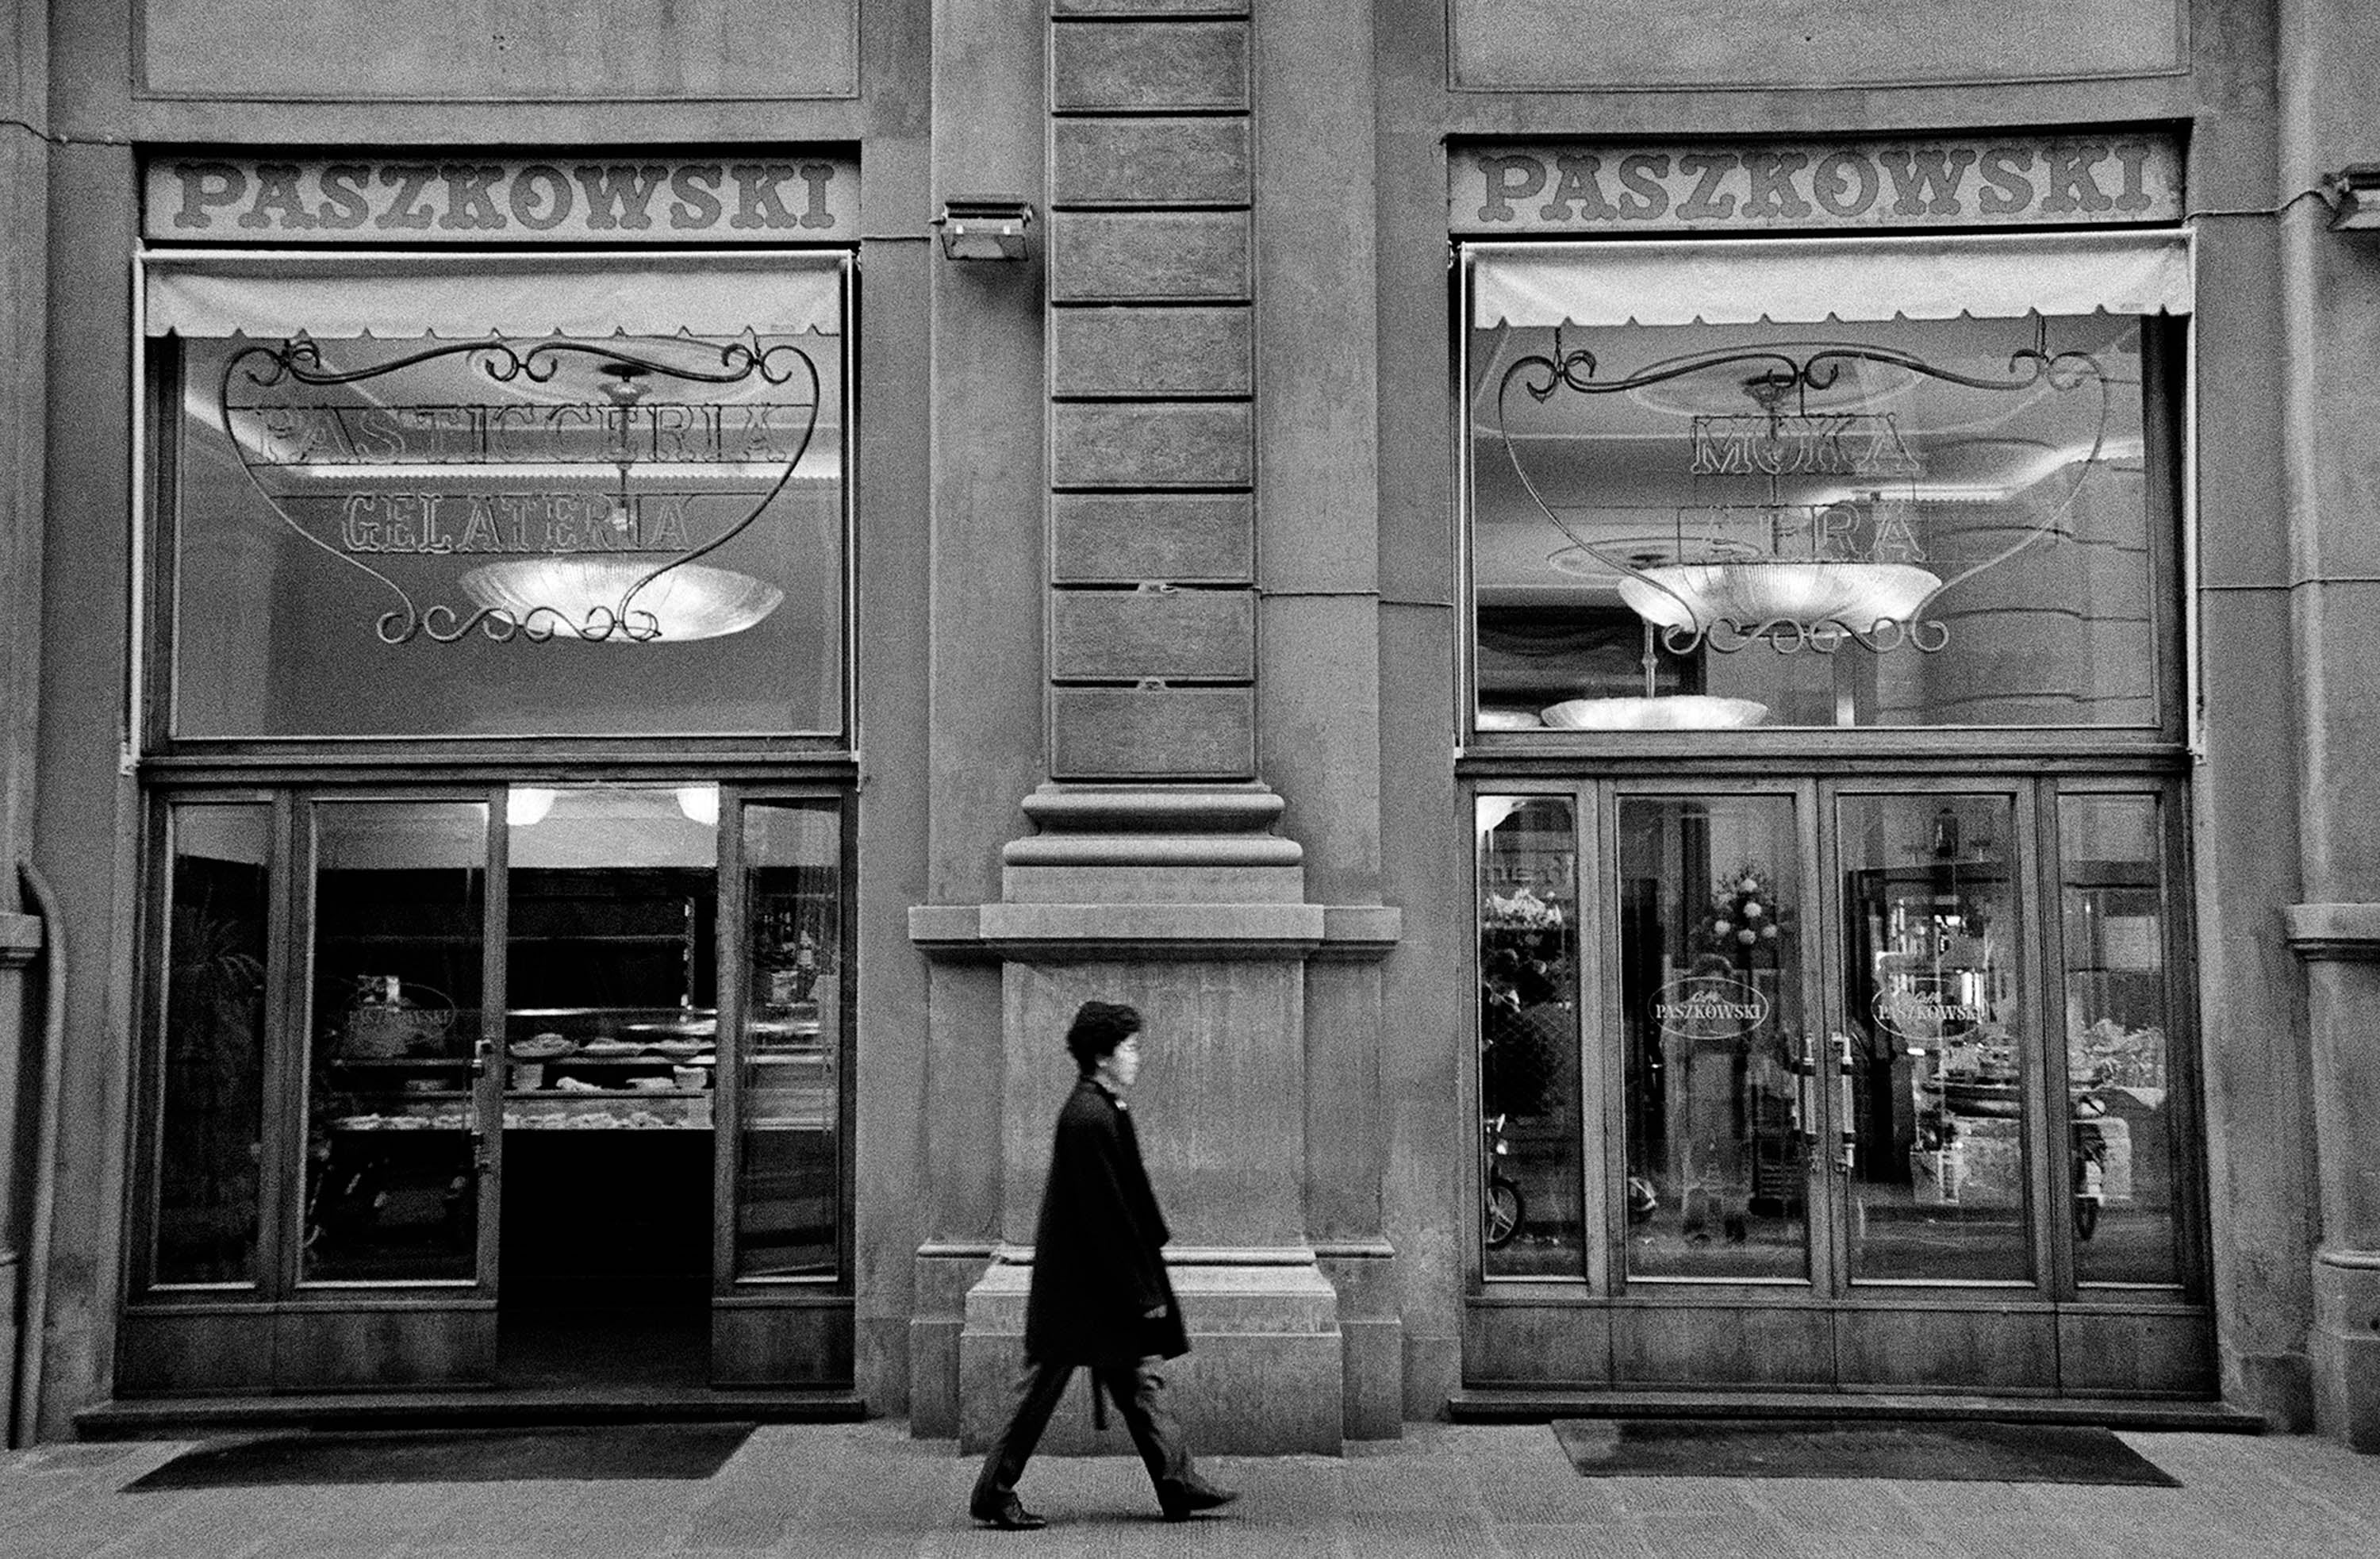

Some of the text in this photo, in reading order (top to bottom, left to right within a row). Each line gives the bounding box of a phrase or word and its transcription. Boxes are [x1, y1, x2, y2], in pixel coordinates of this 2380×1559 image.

[173, 163, 835, 230] PASZKOWSKI
[1477, 145, 2152, 222] PASZKOWSKI
[1690, 412, 1920, 474] MOKA
[342, 490, 693, 553] GELATERIA
[1656, 1004, 1761, 1020] PASZKOWSKI
